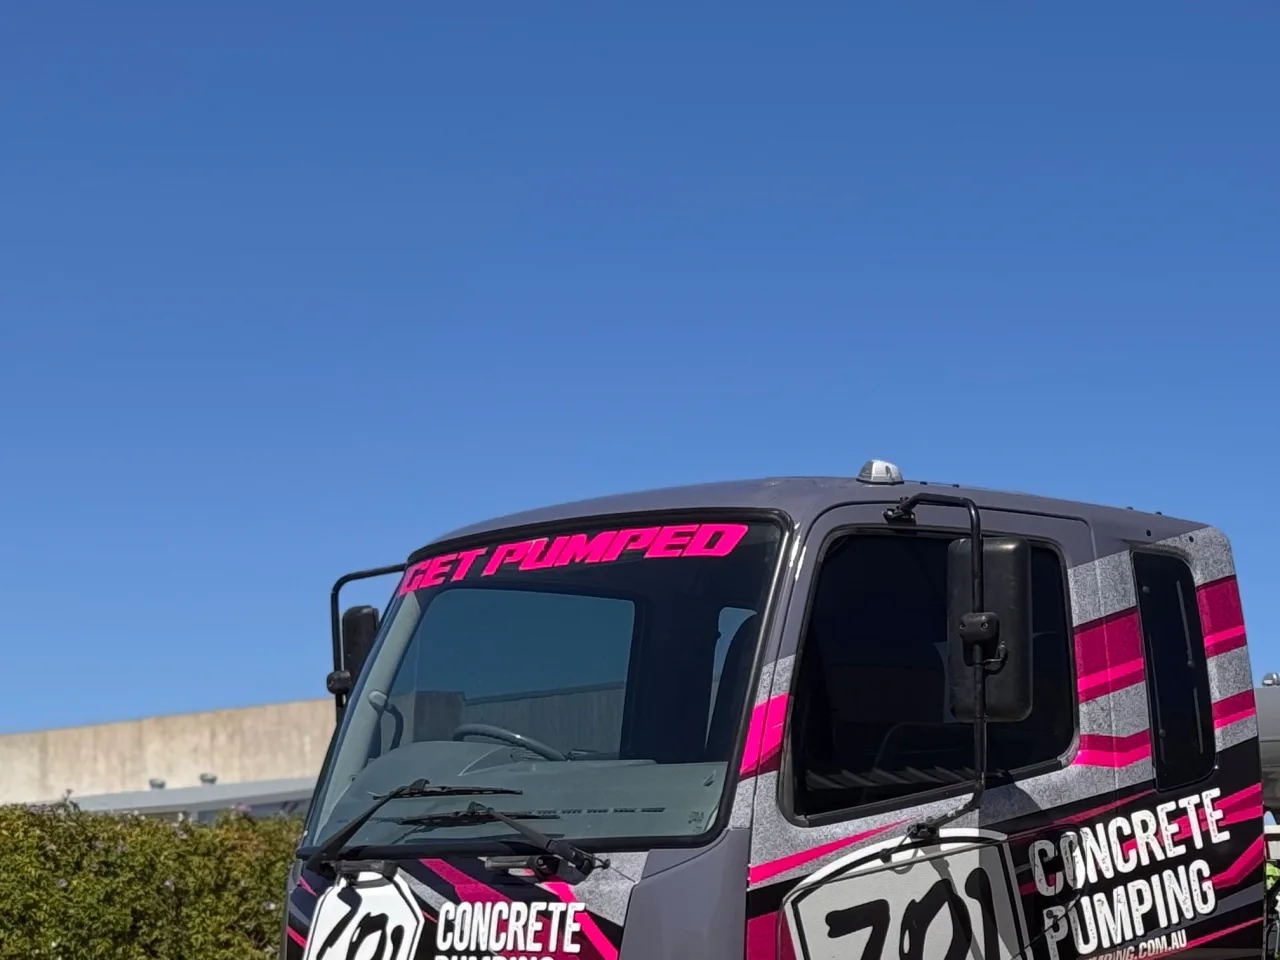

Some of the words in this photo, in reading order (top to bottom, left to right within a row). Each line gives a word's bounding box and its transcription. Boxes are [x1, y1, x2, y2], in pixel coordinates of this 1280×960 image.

[397, 547, 489, 597] GET
[481, 523, 748, 577] PUMPED
[1028, 787, 1231, 898] CONCRETE
[436, 901, 585, 953] CONCRETE
